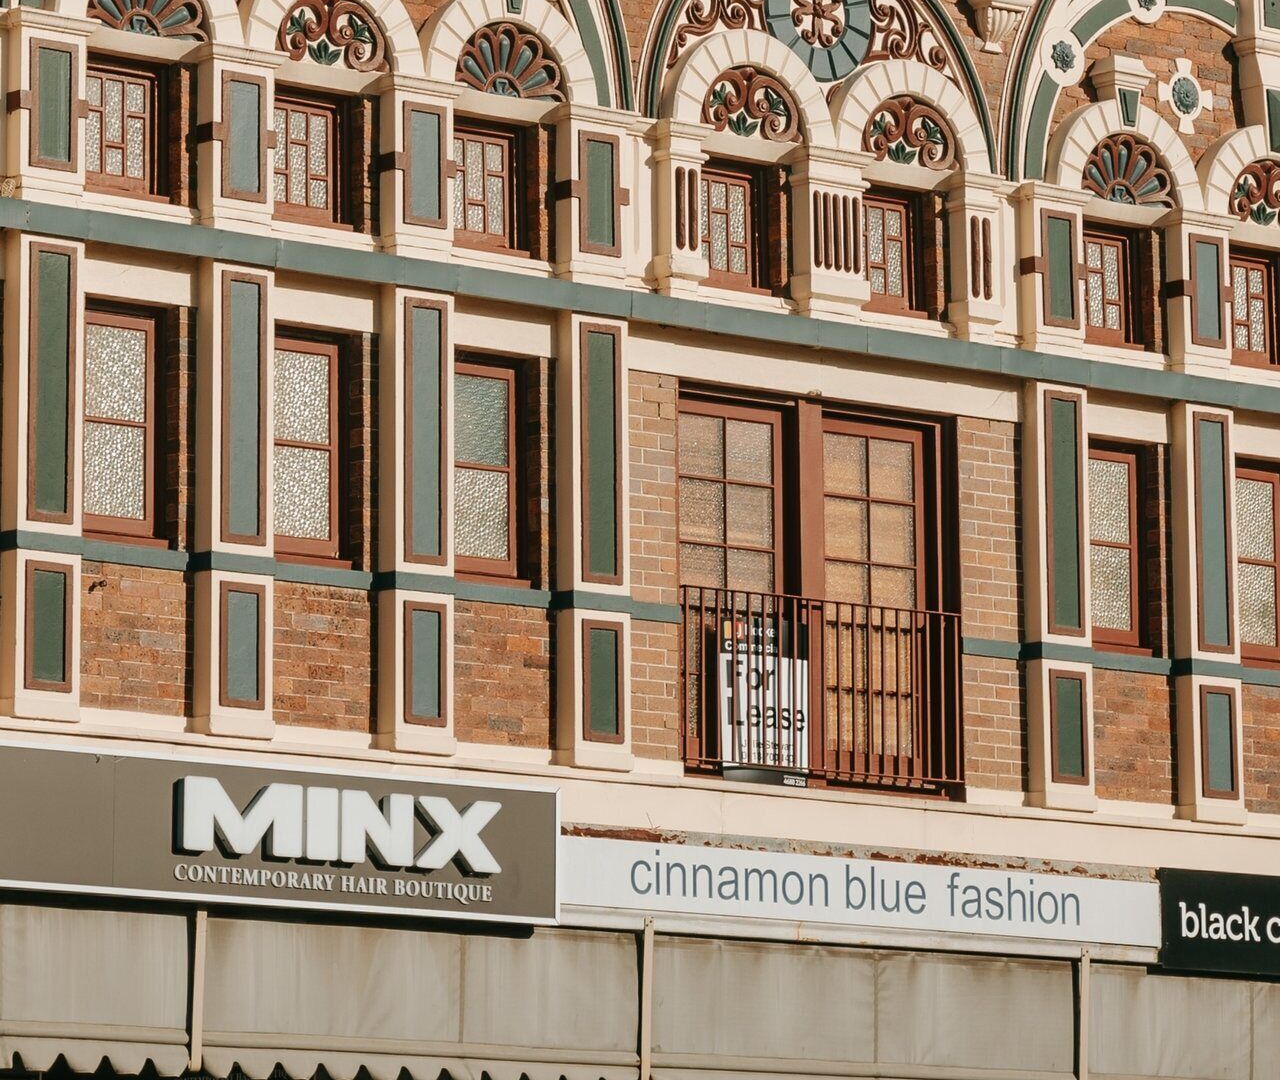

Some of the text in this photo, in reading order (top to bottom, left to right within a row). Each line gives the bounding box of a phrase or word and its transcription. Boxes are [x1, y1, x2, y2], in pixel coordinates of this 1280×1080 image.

[174, 775, 503, 875] MINX
[173, 863, 493, 905] CONTEMPORARY HAIR BOUTIQUE
[630, 849, 1081, 926] cinnamon blue fashion
[1178, 901, 1262, 943] black
